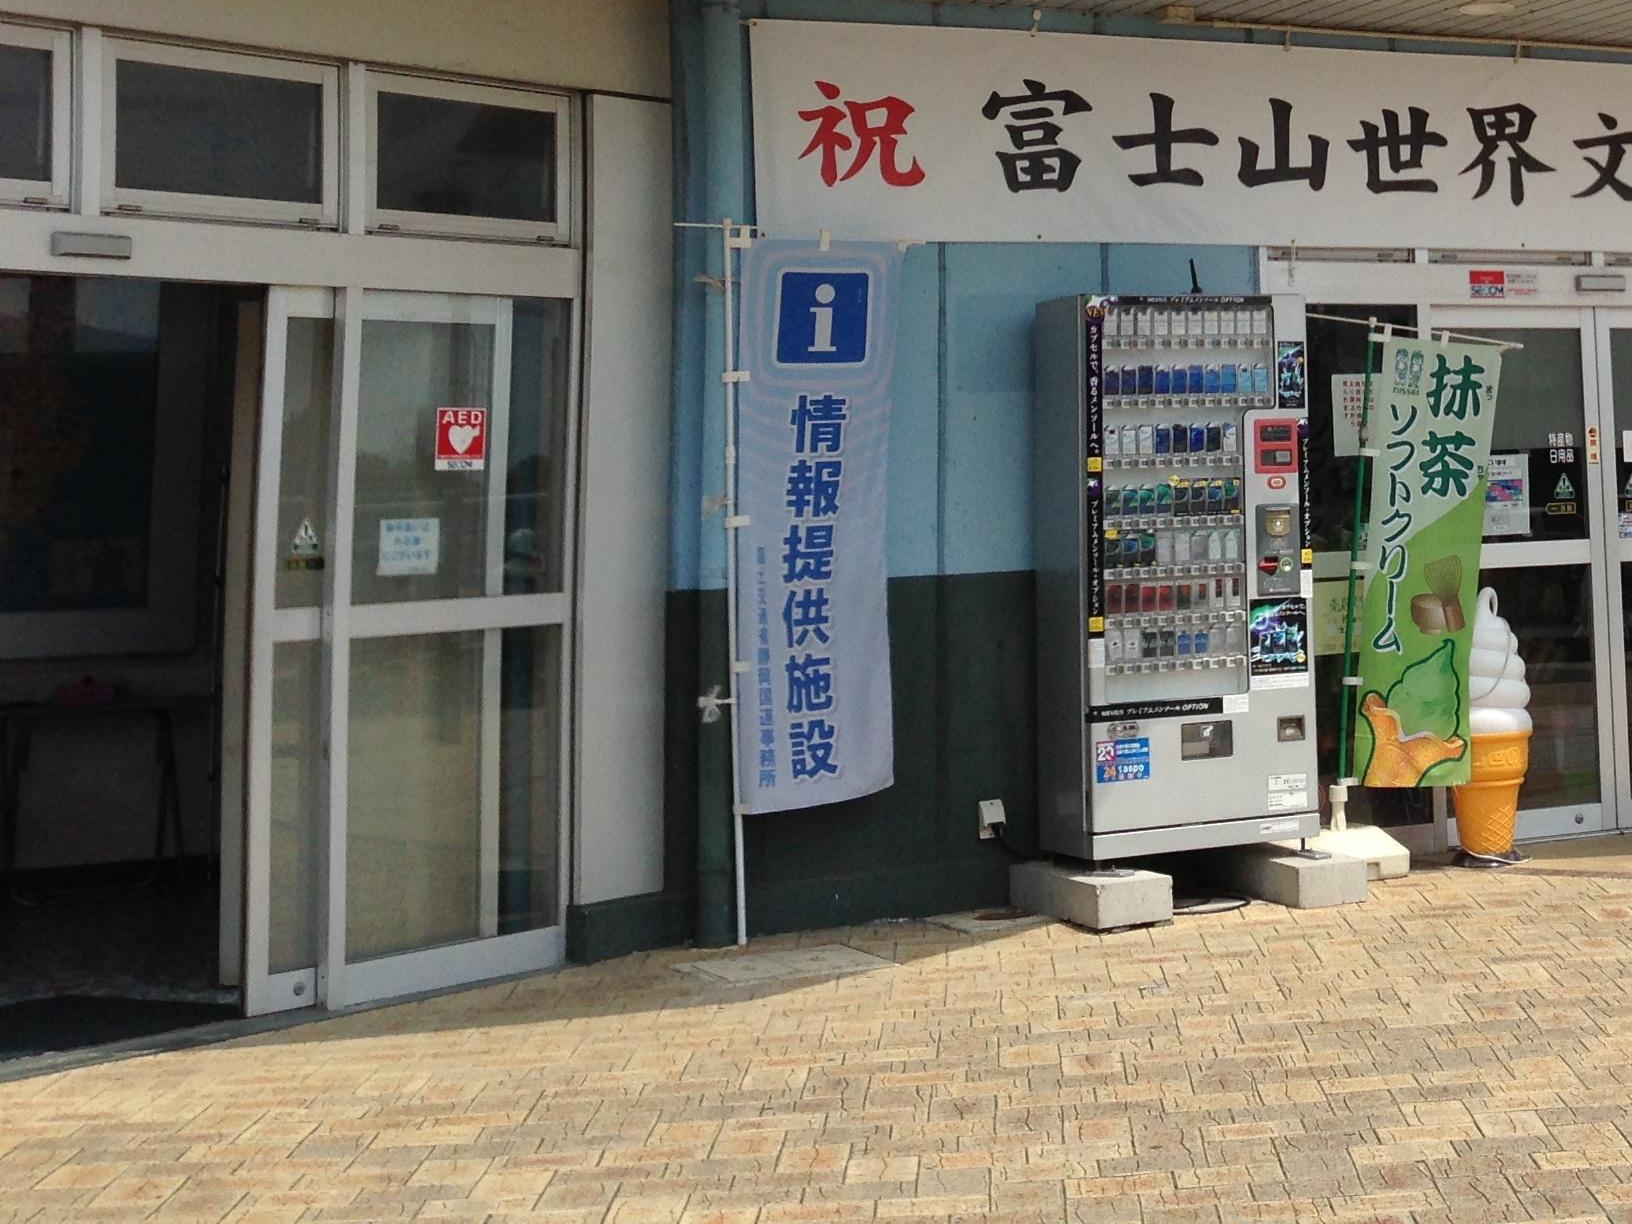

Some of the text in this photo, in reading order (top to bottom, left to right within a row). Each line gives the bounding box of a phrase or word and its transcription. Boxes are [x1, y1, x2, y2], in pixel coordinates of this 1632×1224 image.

[797, 79, 926, 188] 祝
[442, 411, 483, 424] AED
[1419, 353, 1485, 498] 抹茶
[1549, 449, 1574, 463] 日用品
[1373, 403, 1418, 653] ソフトクリーム
[782, 394, 847, 780] 情報提供施設
[1182, 702, 1209, 711] OPTION
